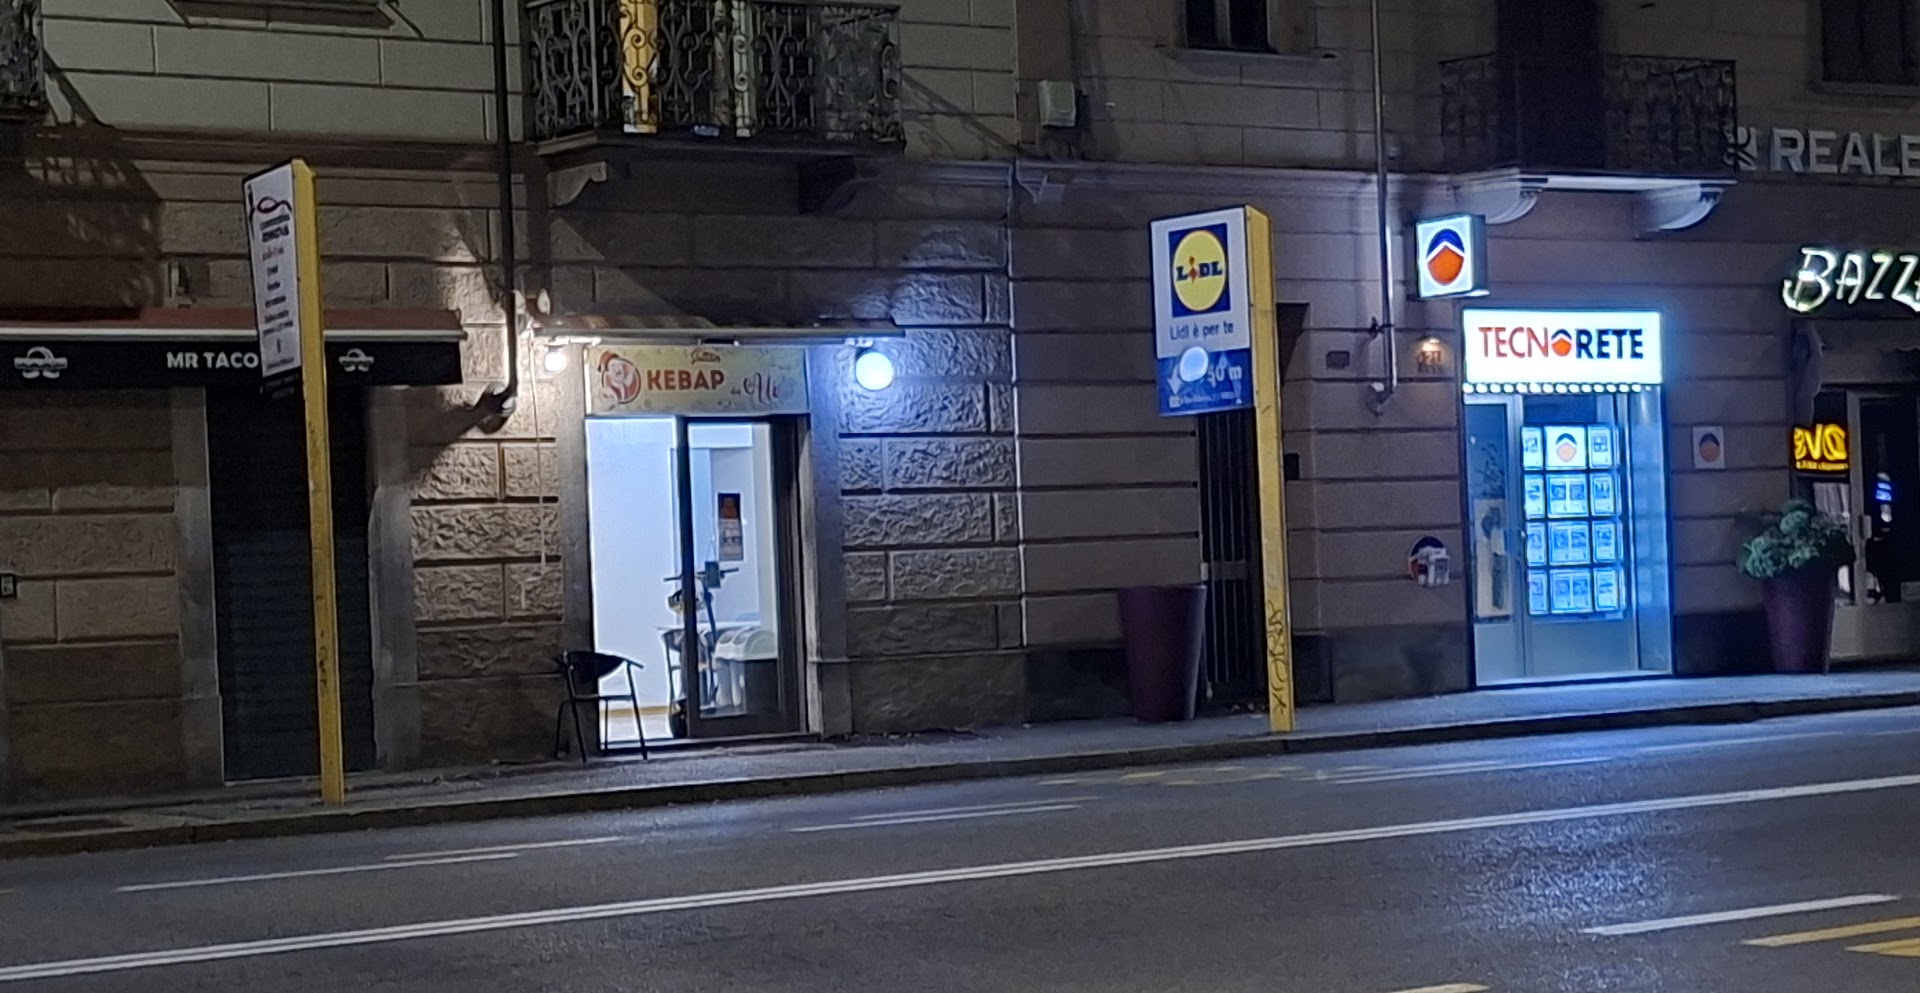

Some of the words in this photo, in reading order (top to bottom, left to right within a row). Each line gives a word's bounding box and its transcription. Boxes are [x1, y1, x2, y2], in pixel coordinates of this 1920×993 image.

[1783, 247, 1920, 313] BAZZ
[1170, 325, 1189, 341] Lidl
[1193, 322, 1199, 338] è
[1202, 323, 1219, 341] per
[1223, 319, 1234, 334] te
[167, 352, 198, 369] MR
[647, 370, 725, 390] KEBAP
